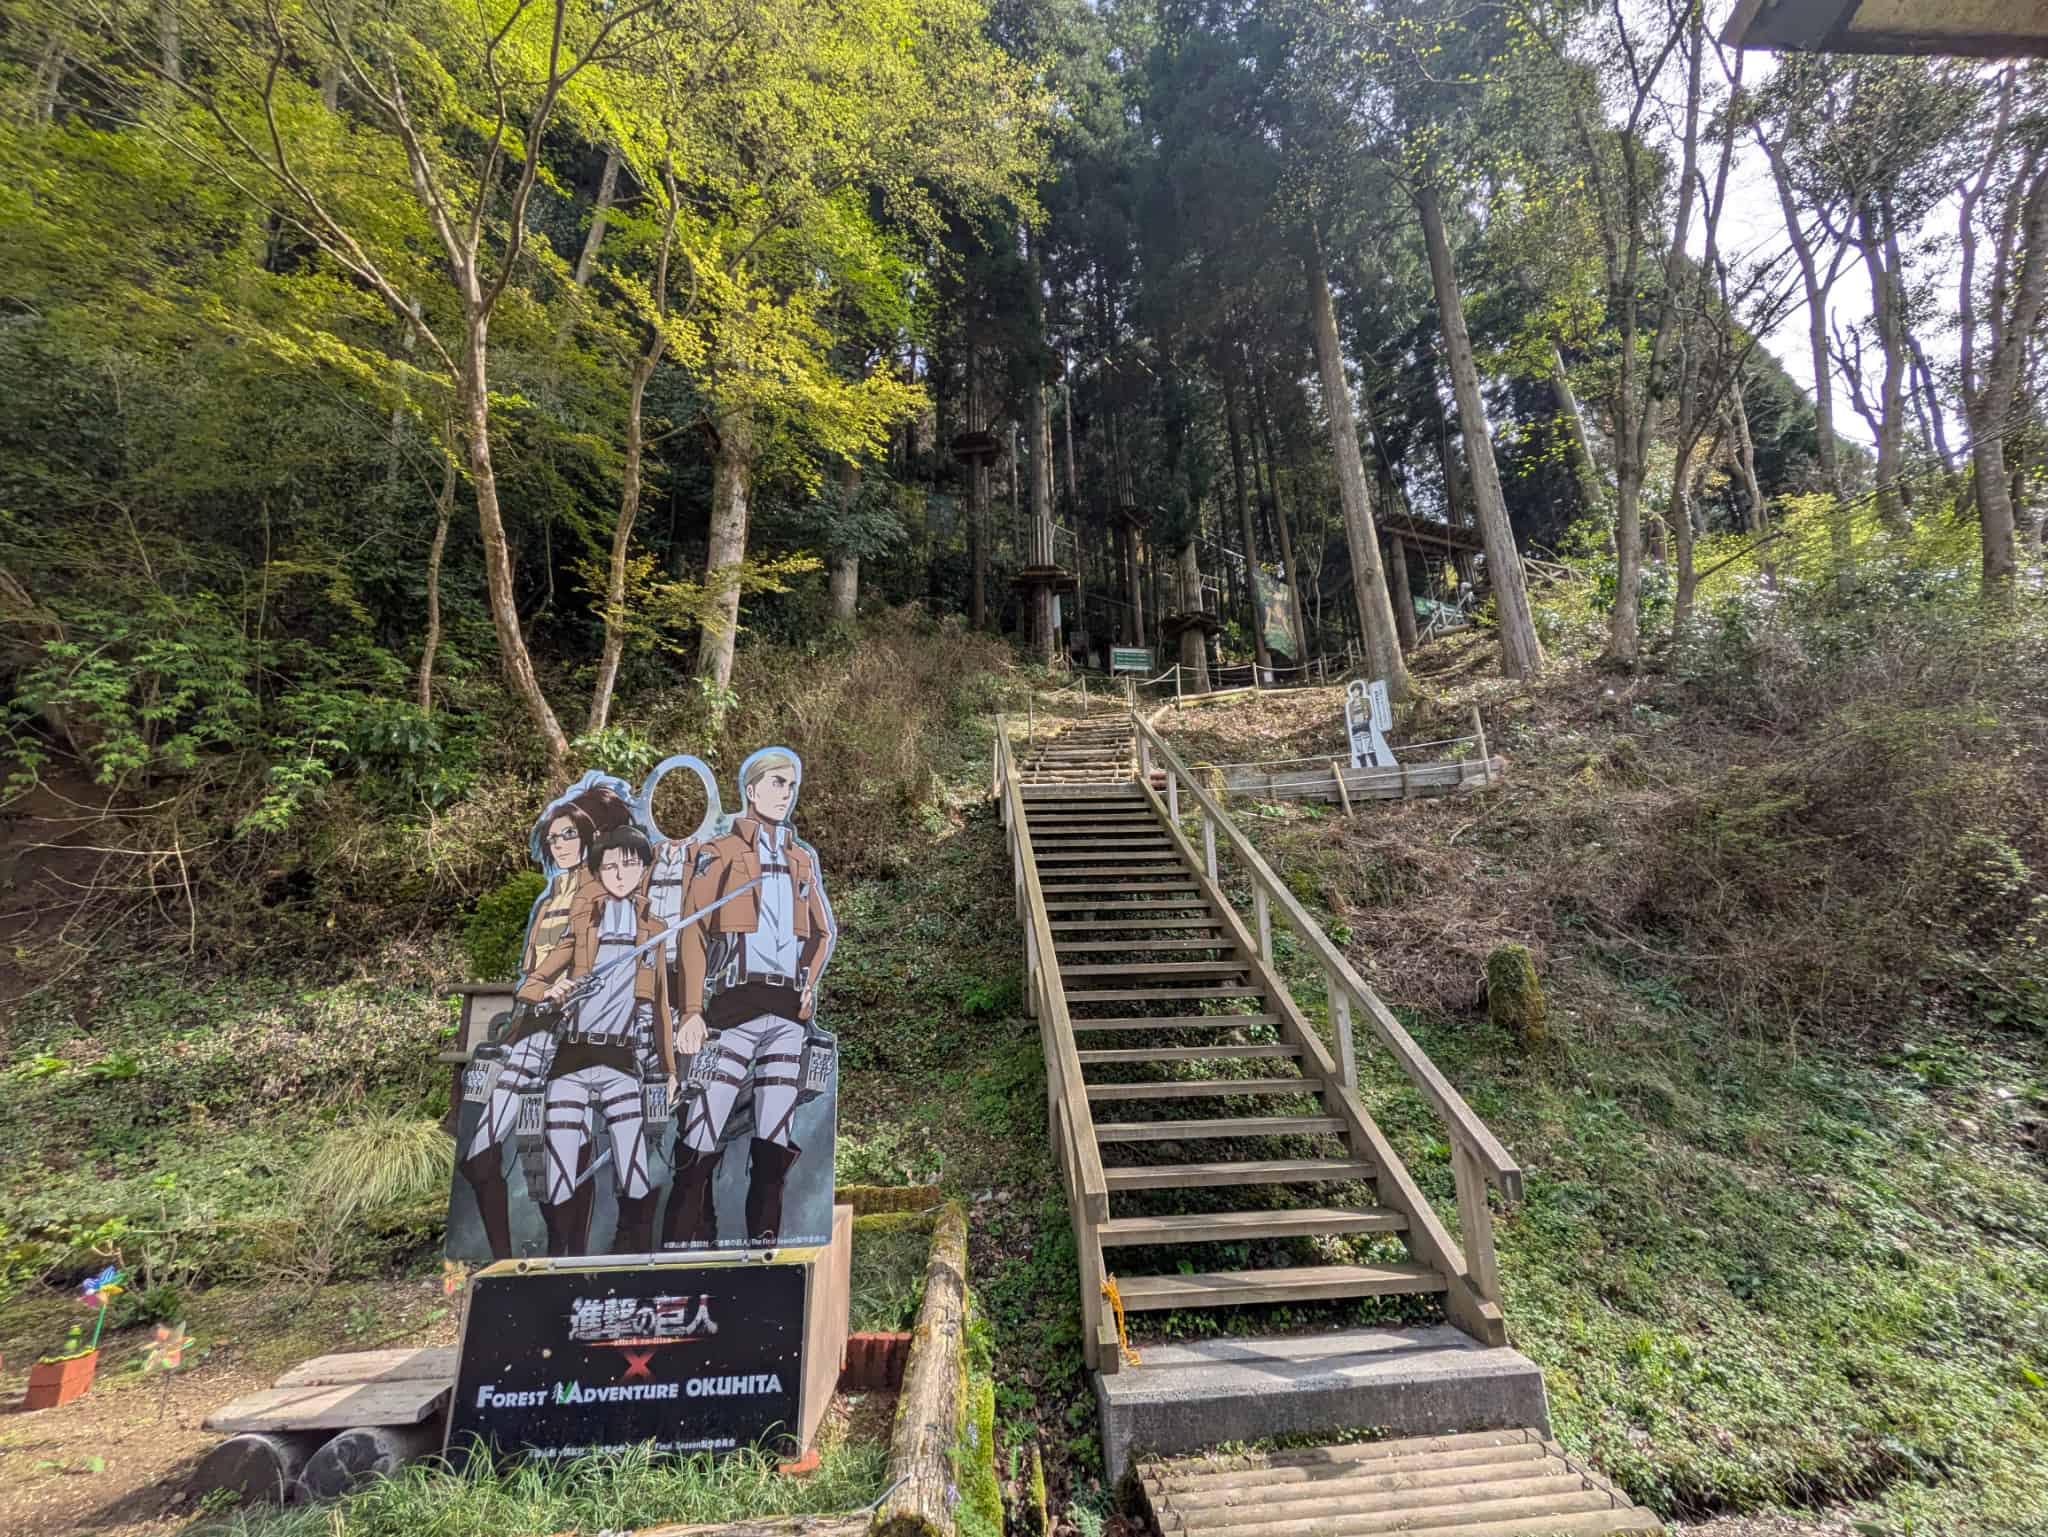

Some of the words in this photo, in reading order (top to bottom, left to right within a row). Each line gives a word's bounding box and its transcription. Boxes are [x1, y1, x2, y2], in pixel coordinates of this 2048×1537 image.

[568, 1294, 718, 1340] 進撃の巨人
[476, 1384, 548, 1408] FOREST
[567, 1379, 679, 1404] ADVENTURE
[686, 1374, 783, 1397] OKUHITA
